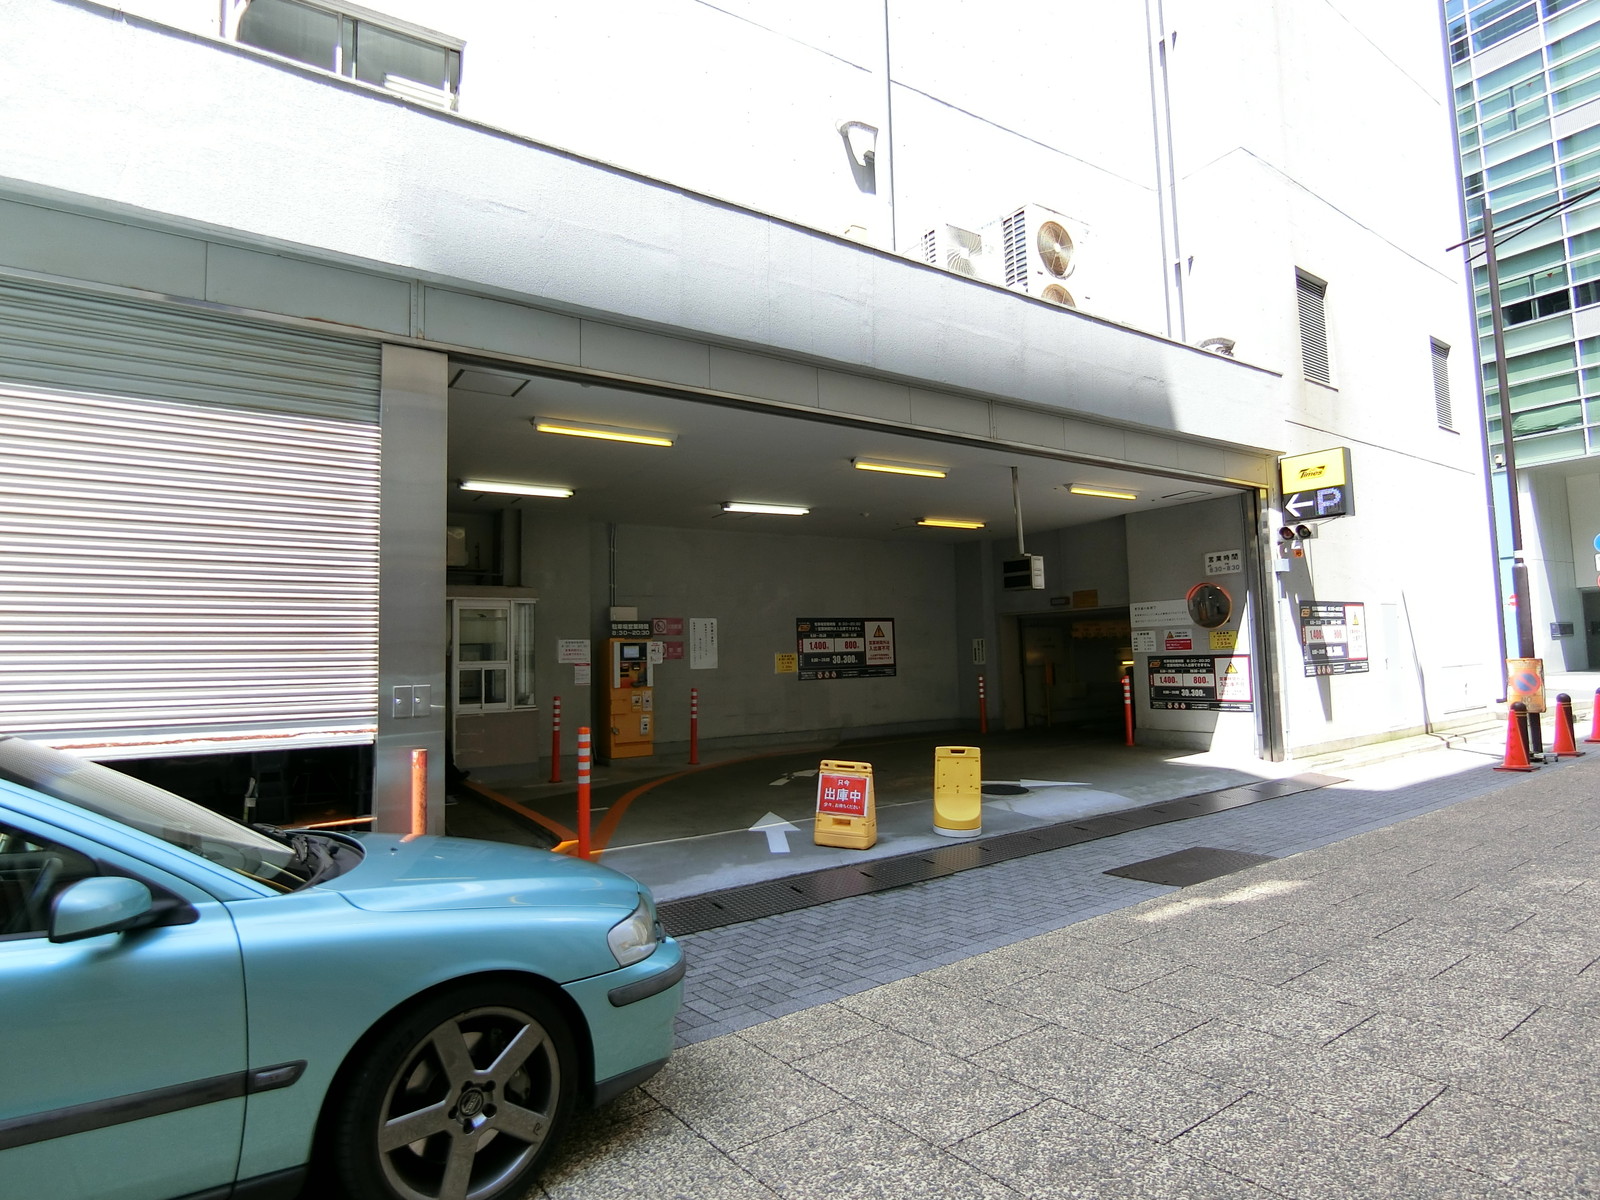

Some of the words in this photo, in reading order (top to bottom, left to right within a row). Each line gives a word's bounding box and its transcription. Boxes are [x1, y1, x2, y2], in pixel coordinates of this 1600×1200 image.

[1299, 466, 1325, 479] Times
[1317, 487, 1341, 515] P
[824, 787, 861, 803] 出庫中
